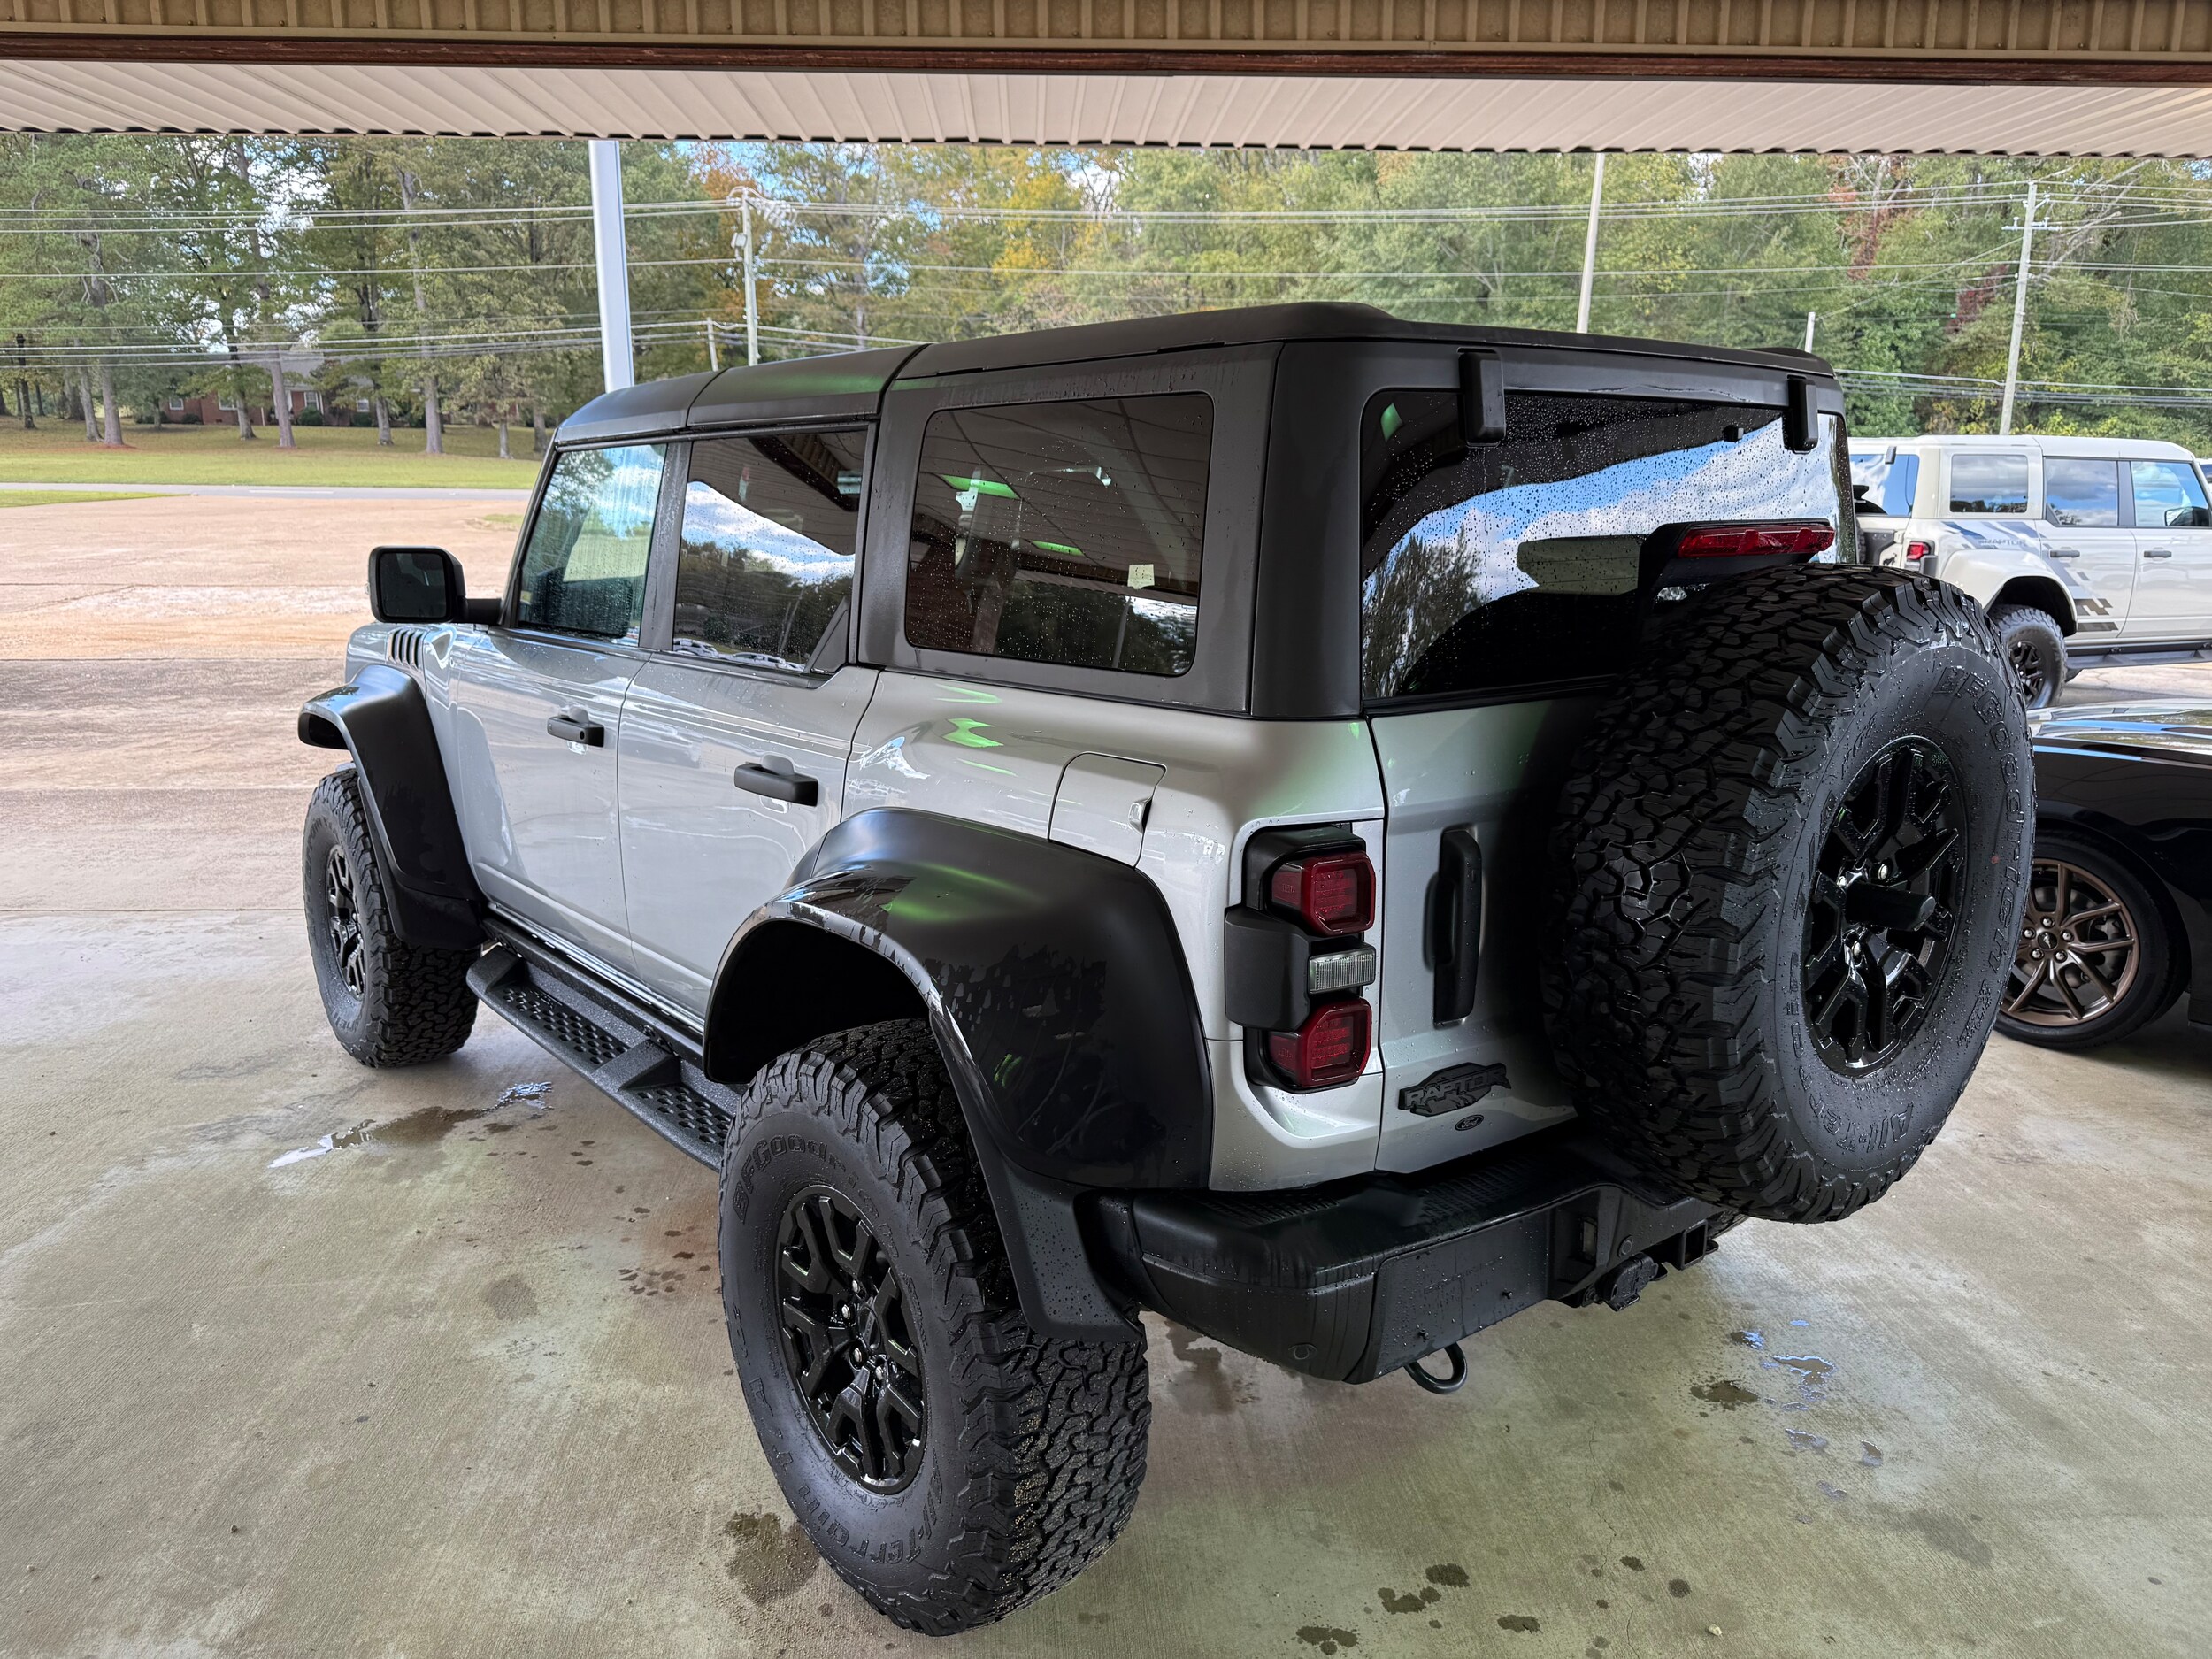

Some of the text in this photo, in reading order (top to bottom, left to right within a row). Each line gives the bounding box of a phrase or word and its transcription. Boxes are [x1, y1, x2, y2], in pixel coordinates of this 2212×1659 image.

[1932, 666, 2024, 974] BFGoodrich
[1404, 1065, 1511, 1113] RAPTOR
[733, 1133, 900, 1258] BFGoodrich
